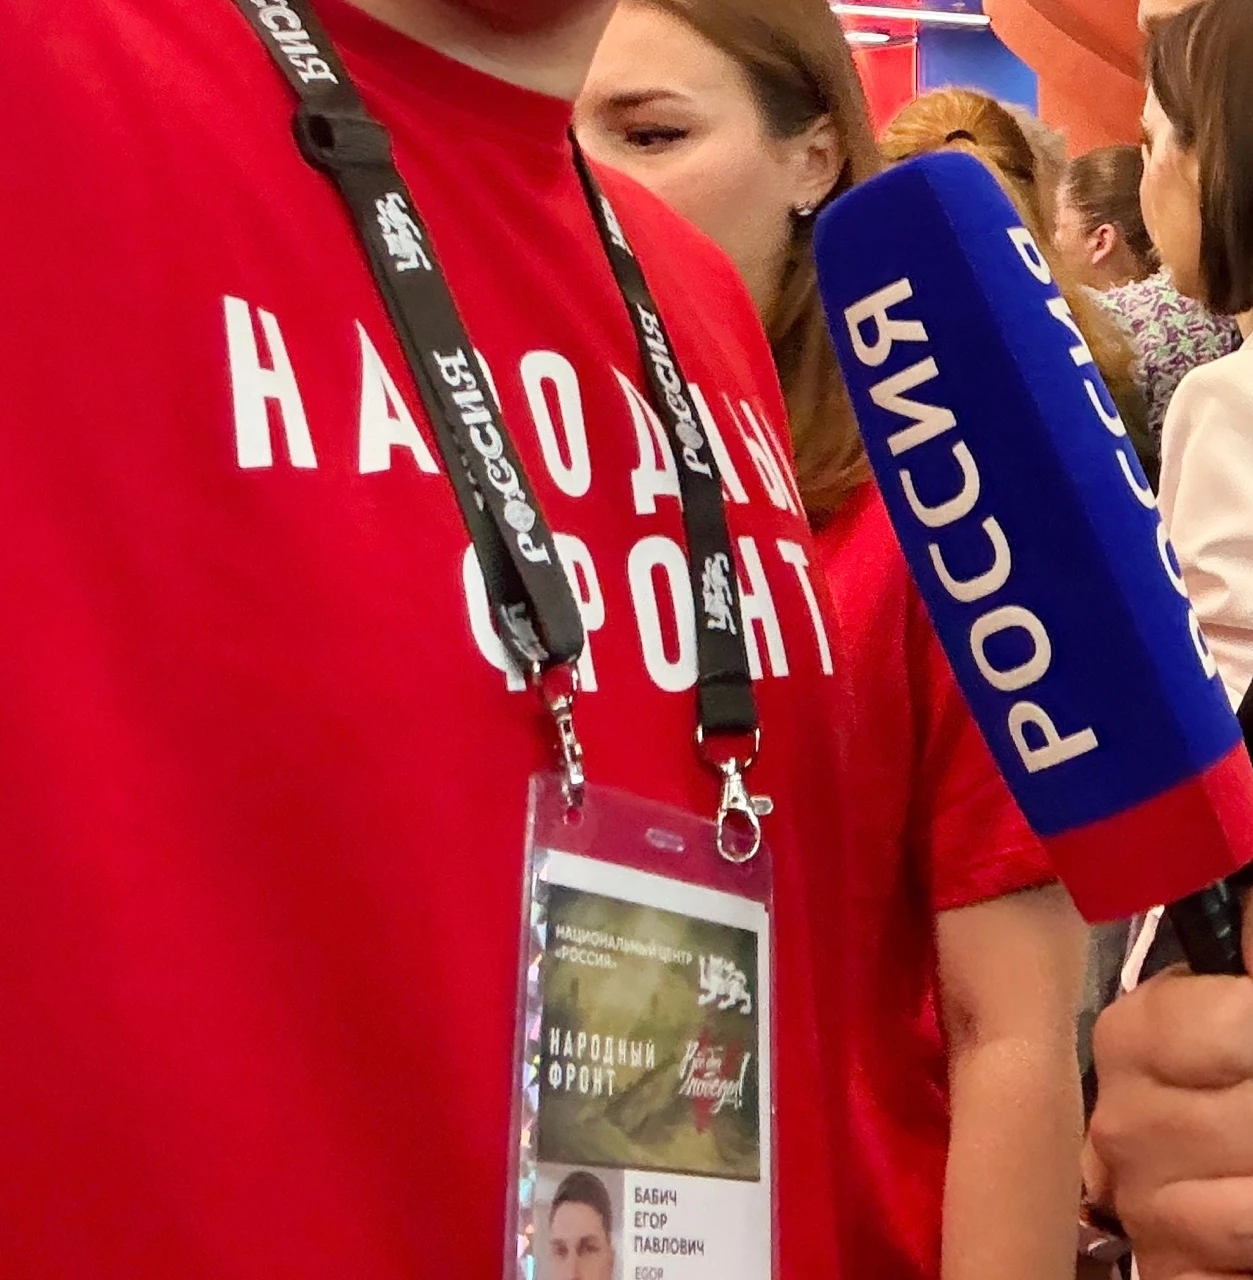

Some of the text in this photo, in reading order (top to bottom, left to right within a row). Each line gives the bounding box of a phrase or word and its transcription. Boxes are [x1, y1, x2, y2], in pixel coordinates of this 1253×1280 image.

[636, 303, 713, 480] РОССИЯ
[432, 347, 552, 566] РОССИЯ
[843, 277, 1100, 775] РОССИЯ
[549, 1027, 656, 1069] НАРОДНЫЙ
[548, 1060, 617, 1097] ФРОНТ
[633, 1187, 678, 1206] БАБИЧ
[633, 1211, 668, 1230] ЕГОР
[633, 1236, 706, 1256] ПАВЛОВИЧ
